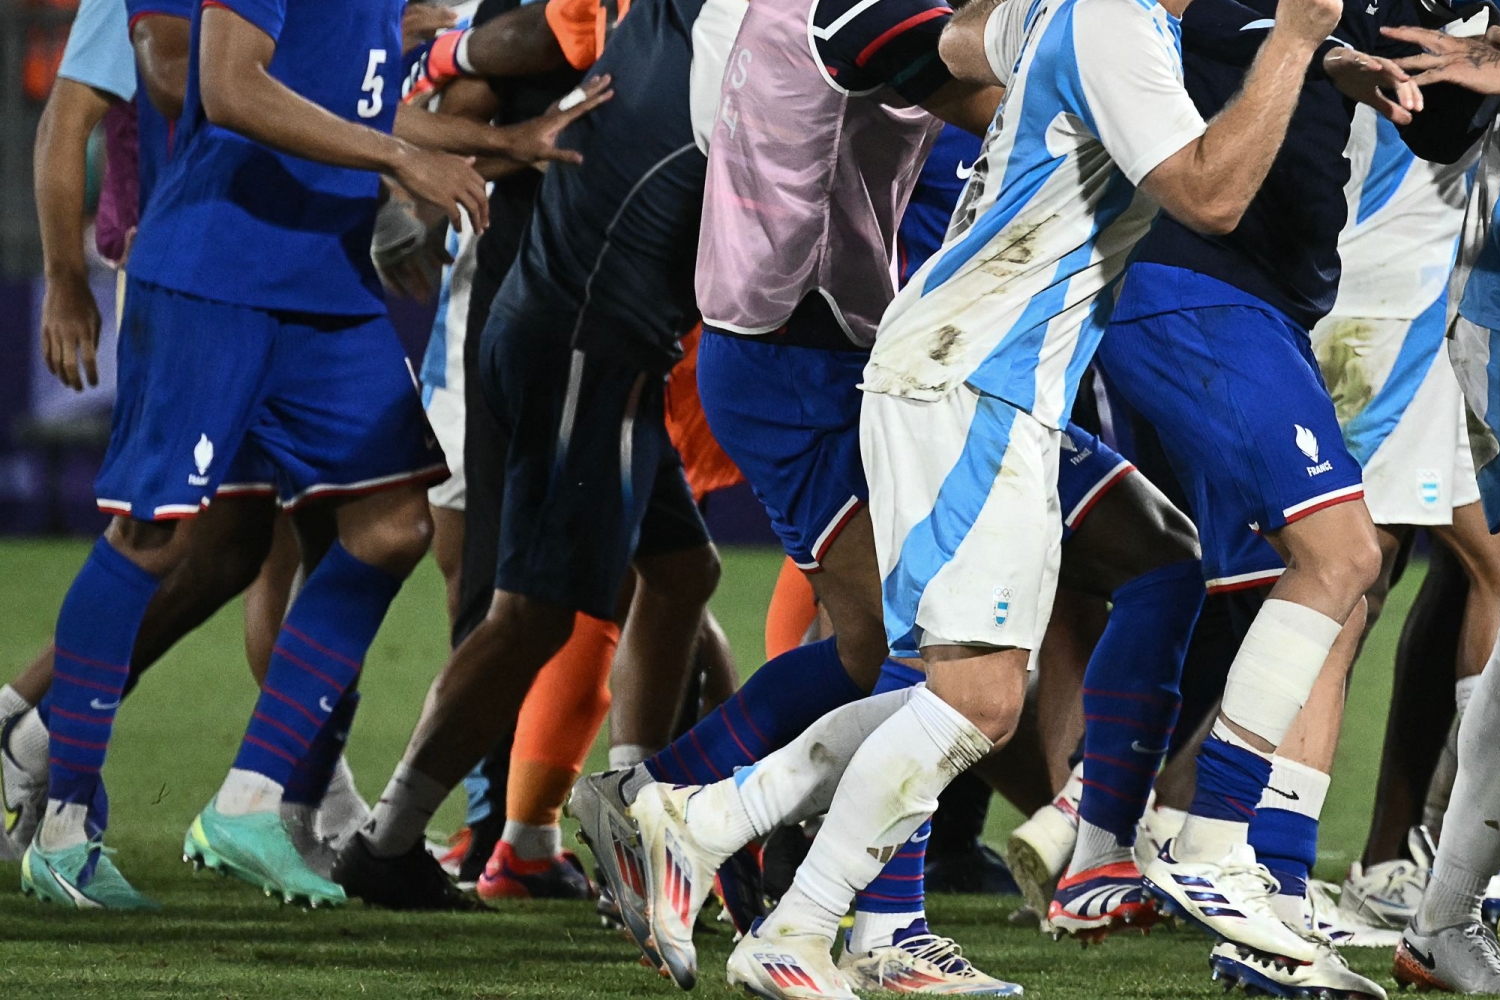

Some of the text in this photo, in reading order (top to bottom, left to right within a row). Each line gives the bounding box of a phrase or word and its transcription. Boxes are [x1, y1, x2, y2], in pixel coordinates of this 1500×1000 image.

[357, 49, 387, 118] 5
[1306, 460, 1333, 477] FRANCE
[753, 952, 797, 965] F50
